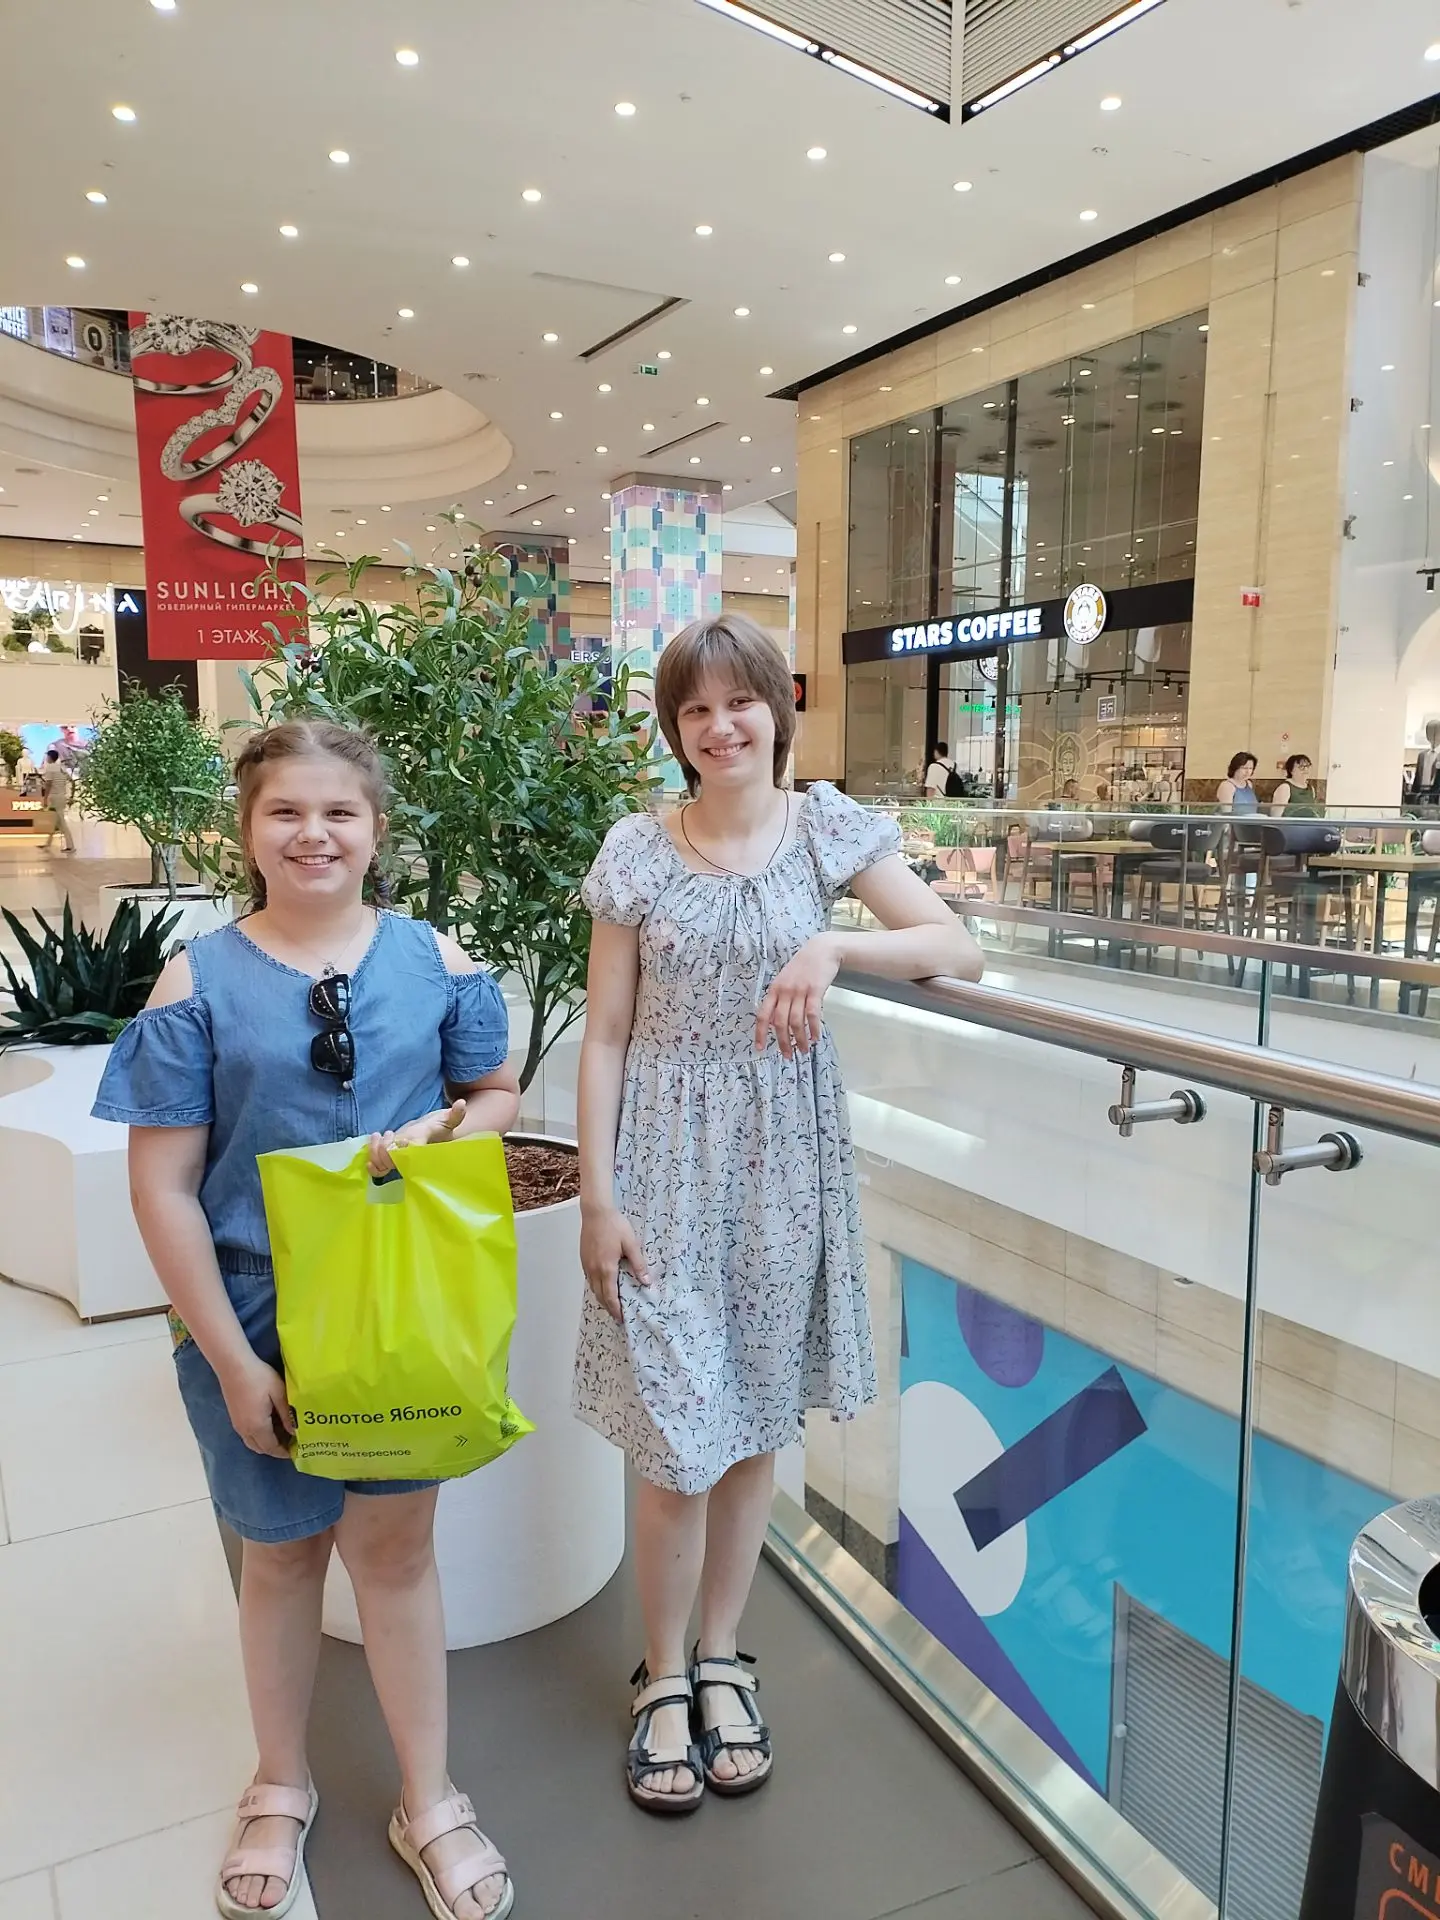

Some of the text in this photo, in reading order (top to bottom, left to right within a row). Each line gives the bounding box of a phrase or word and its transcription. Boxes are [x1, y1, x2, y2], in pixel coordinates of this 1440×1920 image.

[157, 581, 287, 599] SUNLIGH
[157, 602, 222, 611] ЮВЕЛИРНЫЙ
[198, 629, 260, 644] 1 ЭТАЖ
[891, 607, 1042, 652] STARS COFFEE
[303, 1404, 463, 1425] Золотое Яблоко
[298, 1440, 350, 1451] ропусти
[301, 1448, 411, 1459] самое интересное
